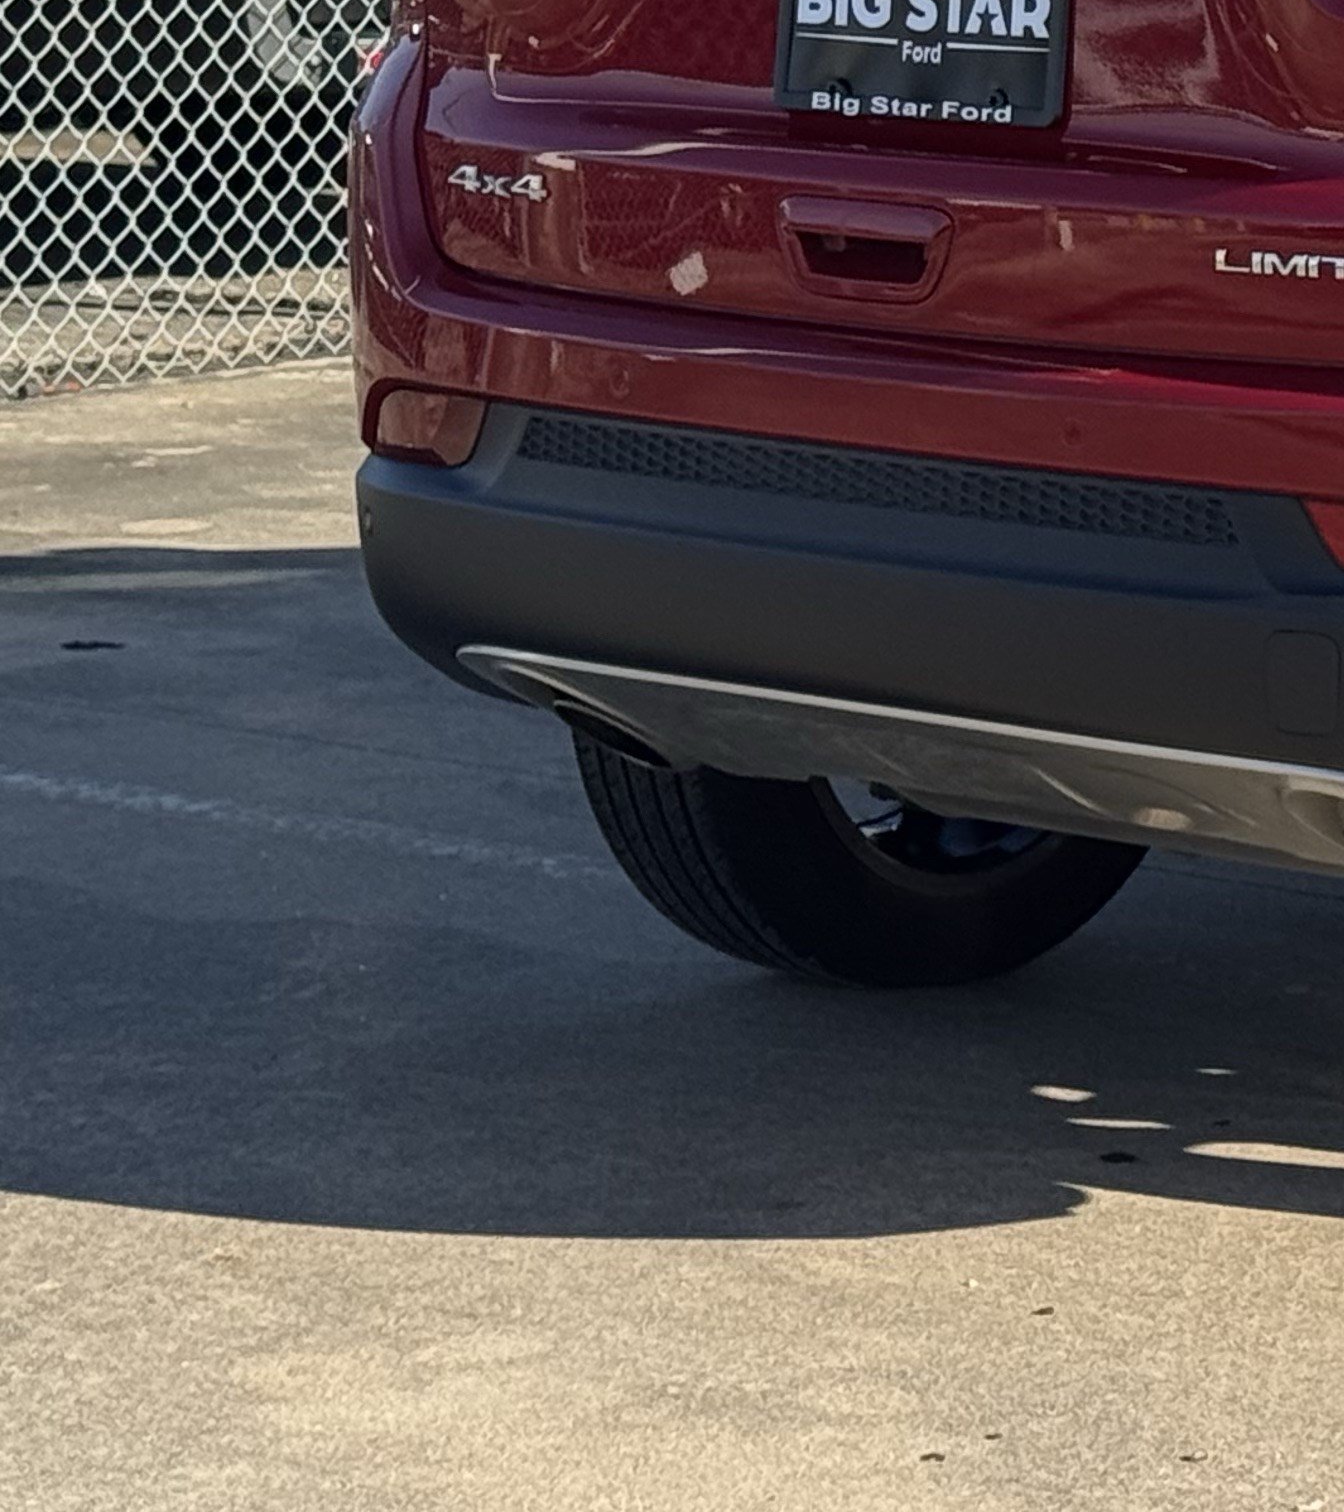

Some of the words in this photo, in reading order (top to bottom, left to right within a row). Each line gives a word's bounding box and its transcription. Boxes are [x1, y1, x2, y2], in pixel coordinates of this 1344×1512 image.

[901, 40, 942, 65] Ford
[811, 91, 860, 117] Big
[870, 95, 932, 120] Star
[941, 100, 1013, 124] Ford
[447, 165, 548, 203] 4x4
